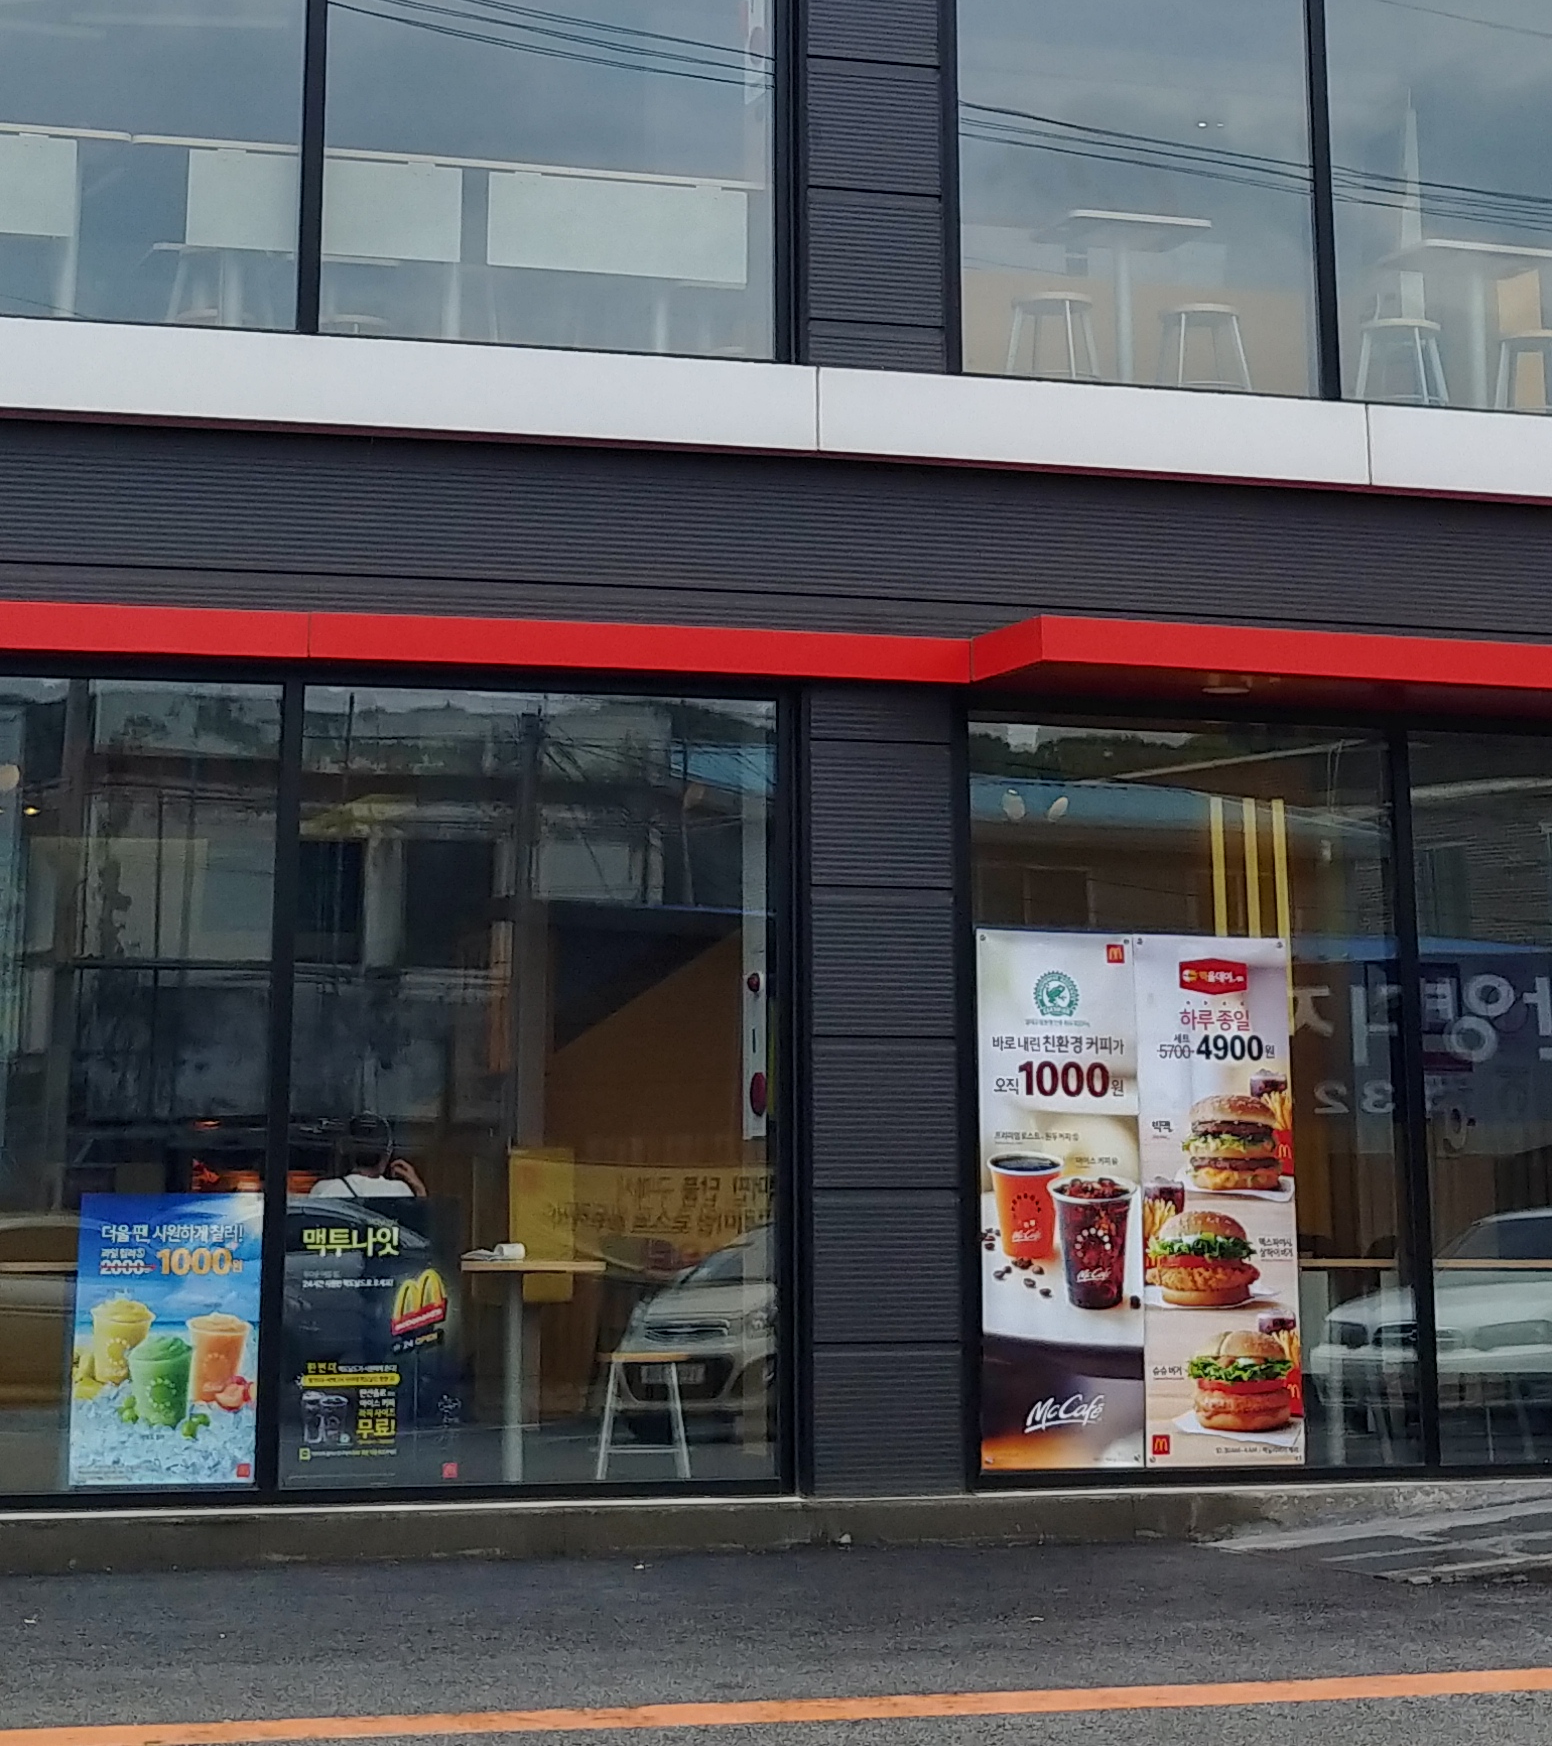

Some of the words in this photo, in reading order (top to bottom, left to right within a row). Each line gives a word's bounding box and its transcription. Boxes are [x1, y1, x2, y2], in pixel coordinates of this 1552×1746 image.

[1179, 1009, 1215, 1031] 하루
[1216, 1009, 1251, 1032] 종일
[992, 1036, 1016, 1051] 바로
[1018, 1037, 1041, 1052] 내린
[1042, 1035, 1083, 1054] 친환경
[1086, 1036, 1125, 1055] 커피가
[1174, 1033, 1190, 1044] 세트
[994, 1077, 1019, 1095] 오직
[102, 1224, 131, 1243] 더울
[152, 1224, 209, 1243] 시원하게
[302, 1226, 400, 1258] 맥투나잇
[1152, 1365, 1167, 1376] 슈슈
[1168, 1365, 1183, 1376] 버거
[356, 1418, 396, 1439] 무료!
